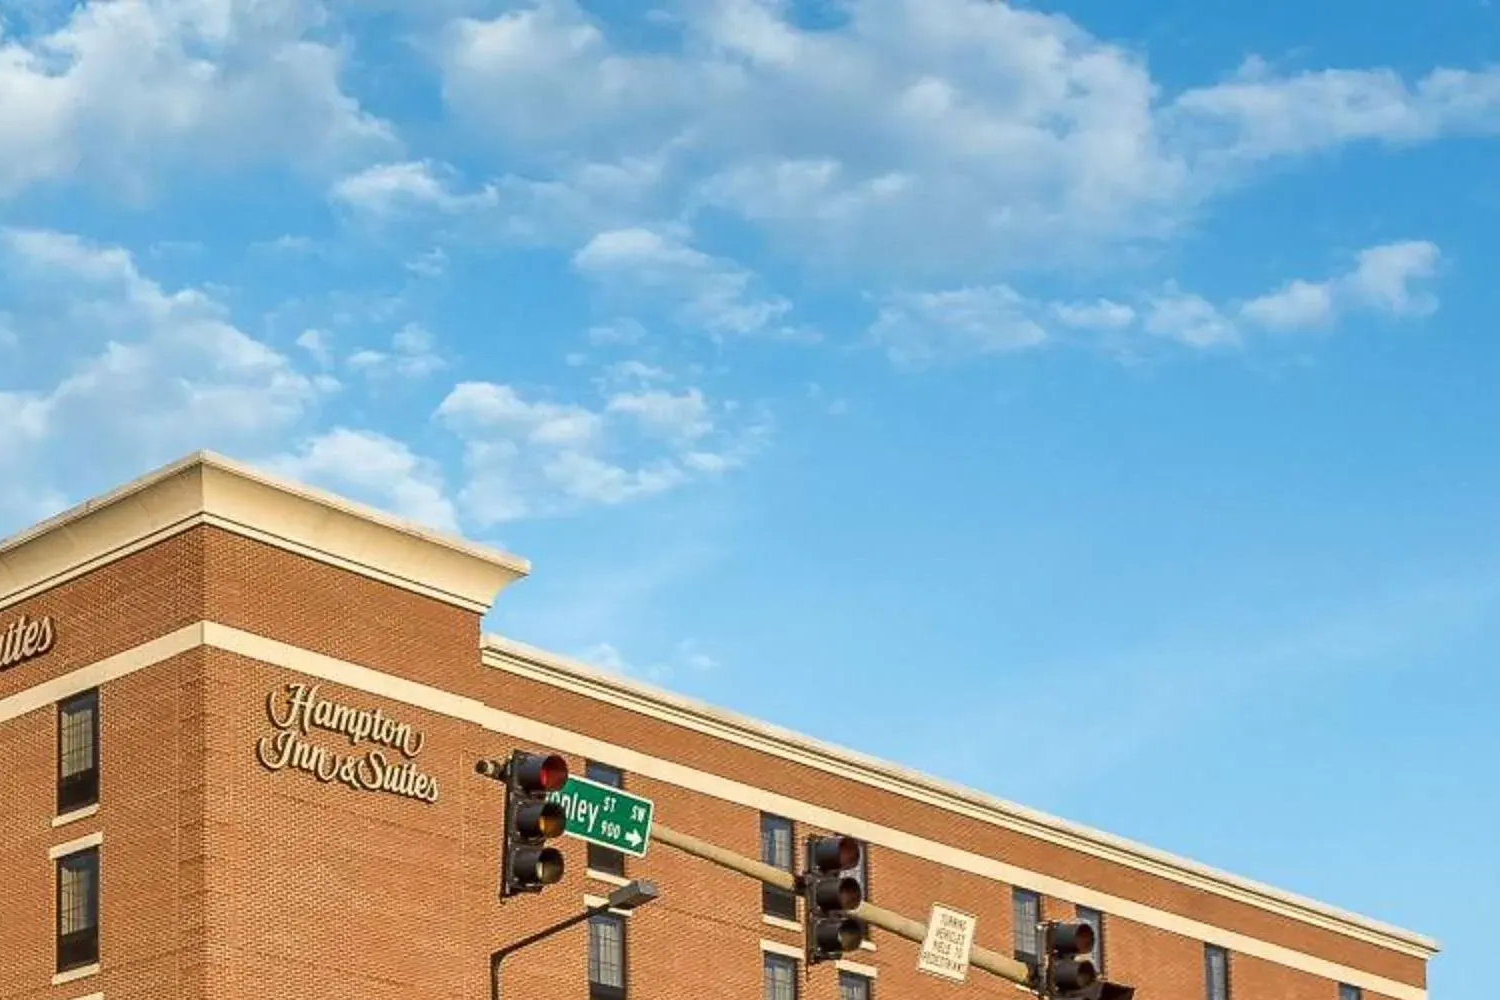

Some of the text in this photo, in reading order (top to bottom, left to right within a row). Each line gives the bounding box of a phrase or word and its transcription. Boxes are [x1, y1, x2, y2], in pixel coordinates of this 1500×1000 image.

[269, 683, 425, 757] Hampton
[259, 731, 340, 781] Inn
[357, 750, 440, 802] Suites
[544, 790, 599, 833] nley
[631, 805, 647, 823] SW
